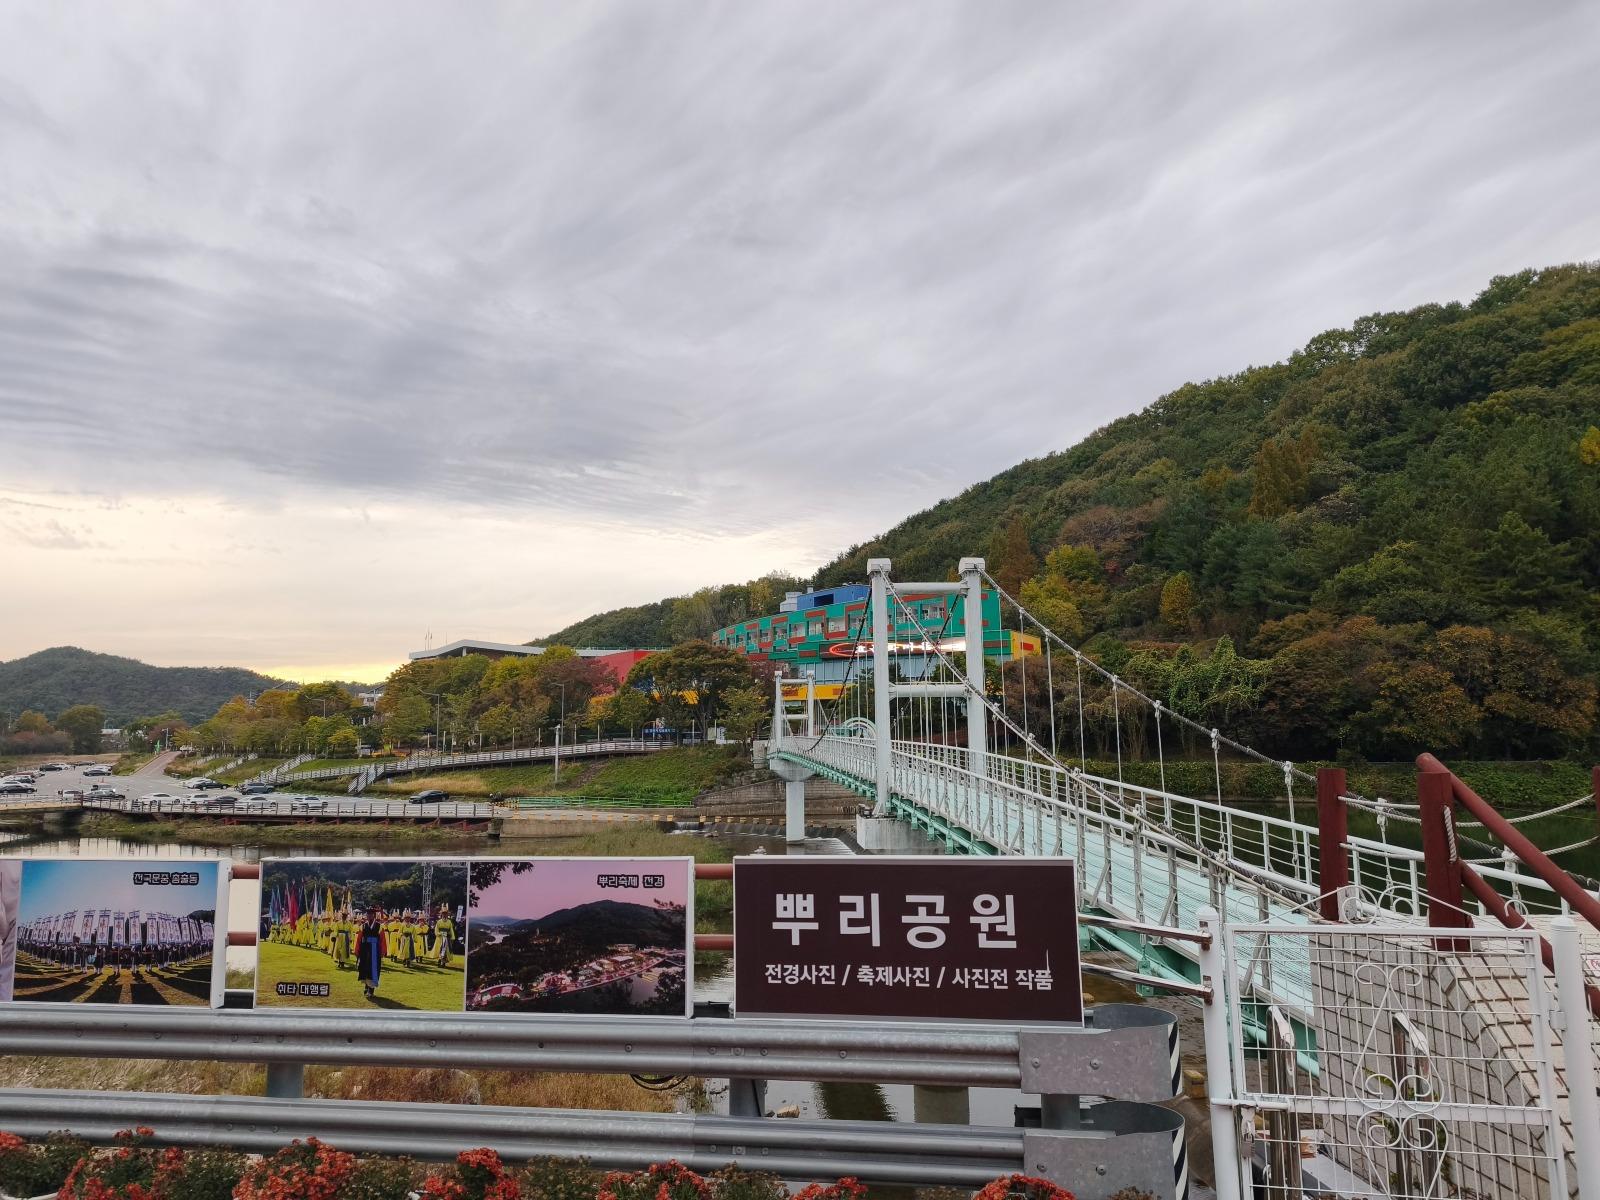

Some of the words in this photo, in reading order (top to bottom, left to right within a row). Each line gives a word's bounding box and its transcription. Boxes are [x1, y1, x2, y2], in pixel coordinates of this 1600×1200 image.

[598, 874, 639, 888] 뿌리축제
[643, 875, 664, 888] 전경
[772, 893, 1017, 949] 뿌리공원
[764, 964, 836, 986] 전경사진
[856, 965, 931, 988] 축제사진
[952, 967, 1009, 990] 사진전
[1015, 968, 1053, 991] 작품
[277, 983, 297, 995] 취타
[300, 983, 329, 996] 대행렬
